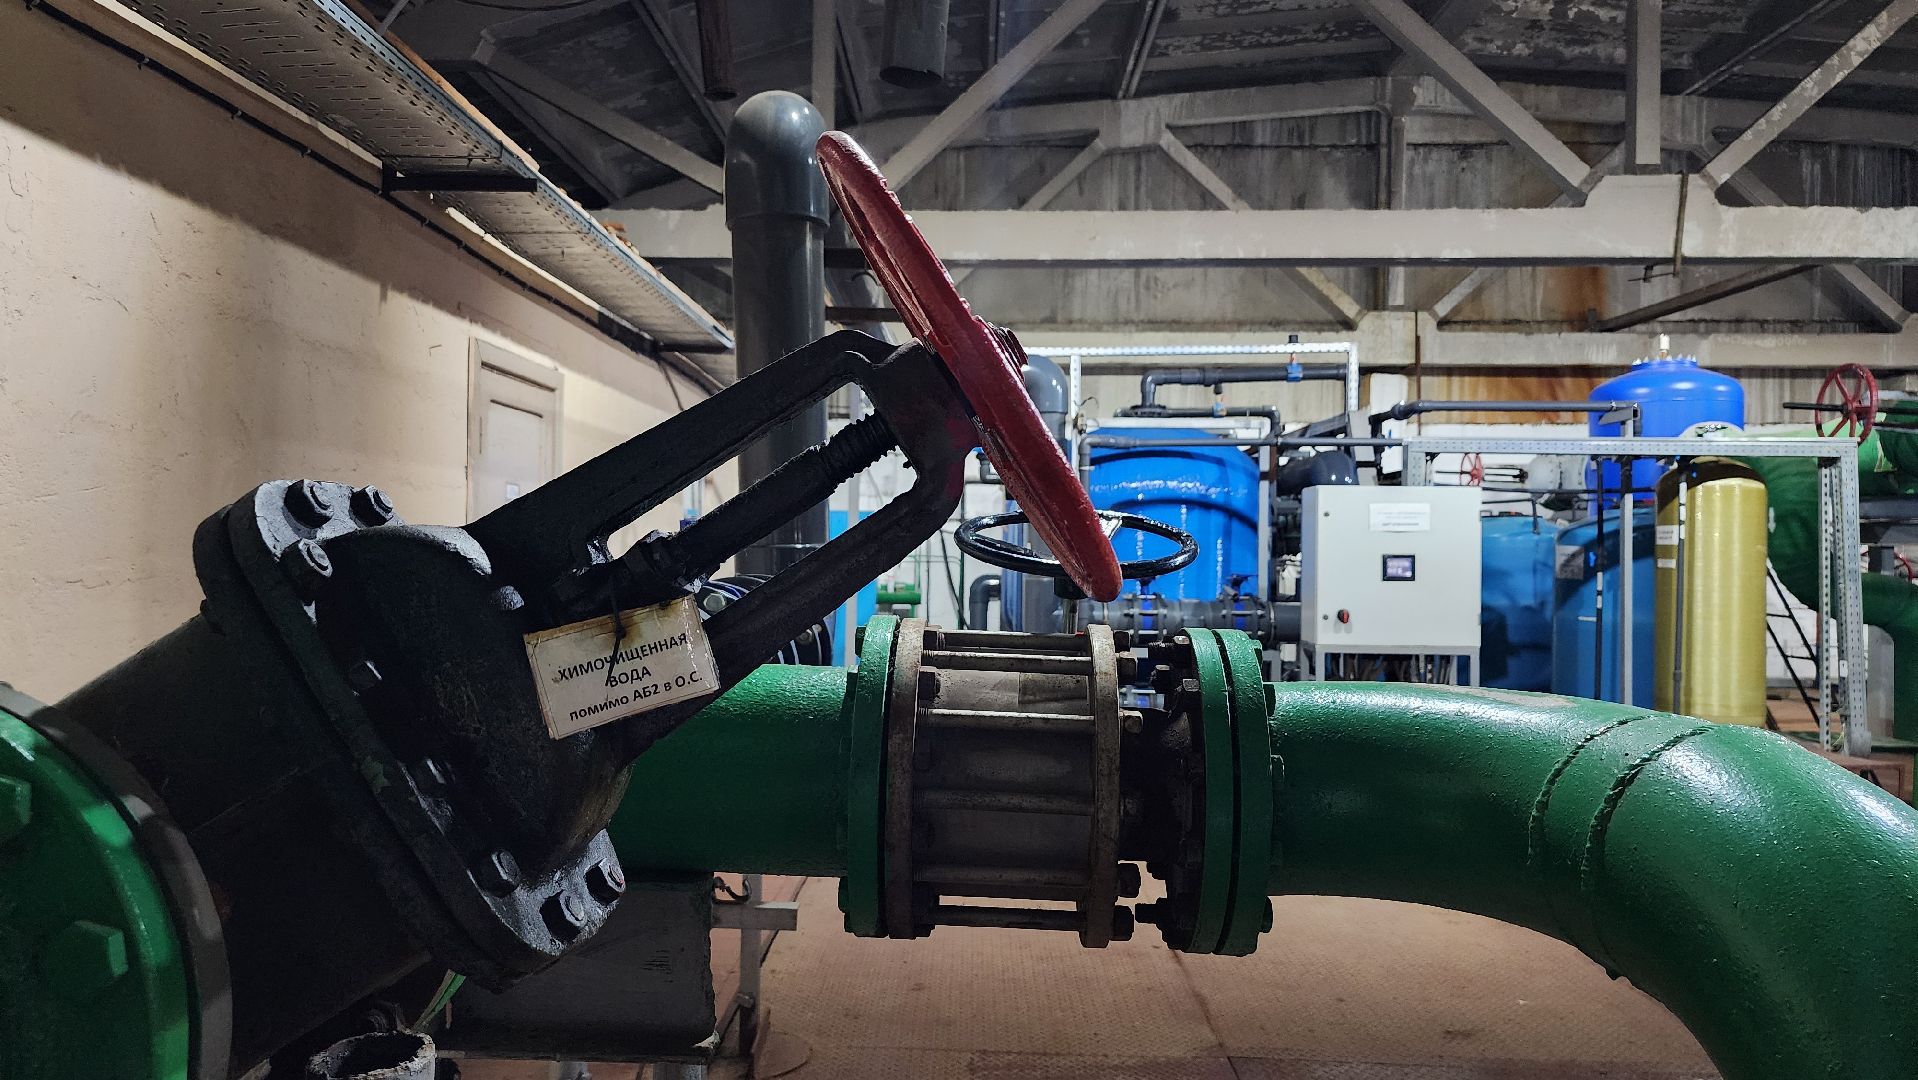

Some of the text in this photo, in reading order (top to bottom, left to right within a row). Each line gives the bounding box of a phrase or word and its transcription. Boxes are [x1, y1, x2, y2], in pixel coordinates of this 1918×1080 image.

[609, 665, 652, 688] ВОДА
[569, 671, 703, 721] помимо АБ2 в О.С.
